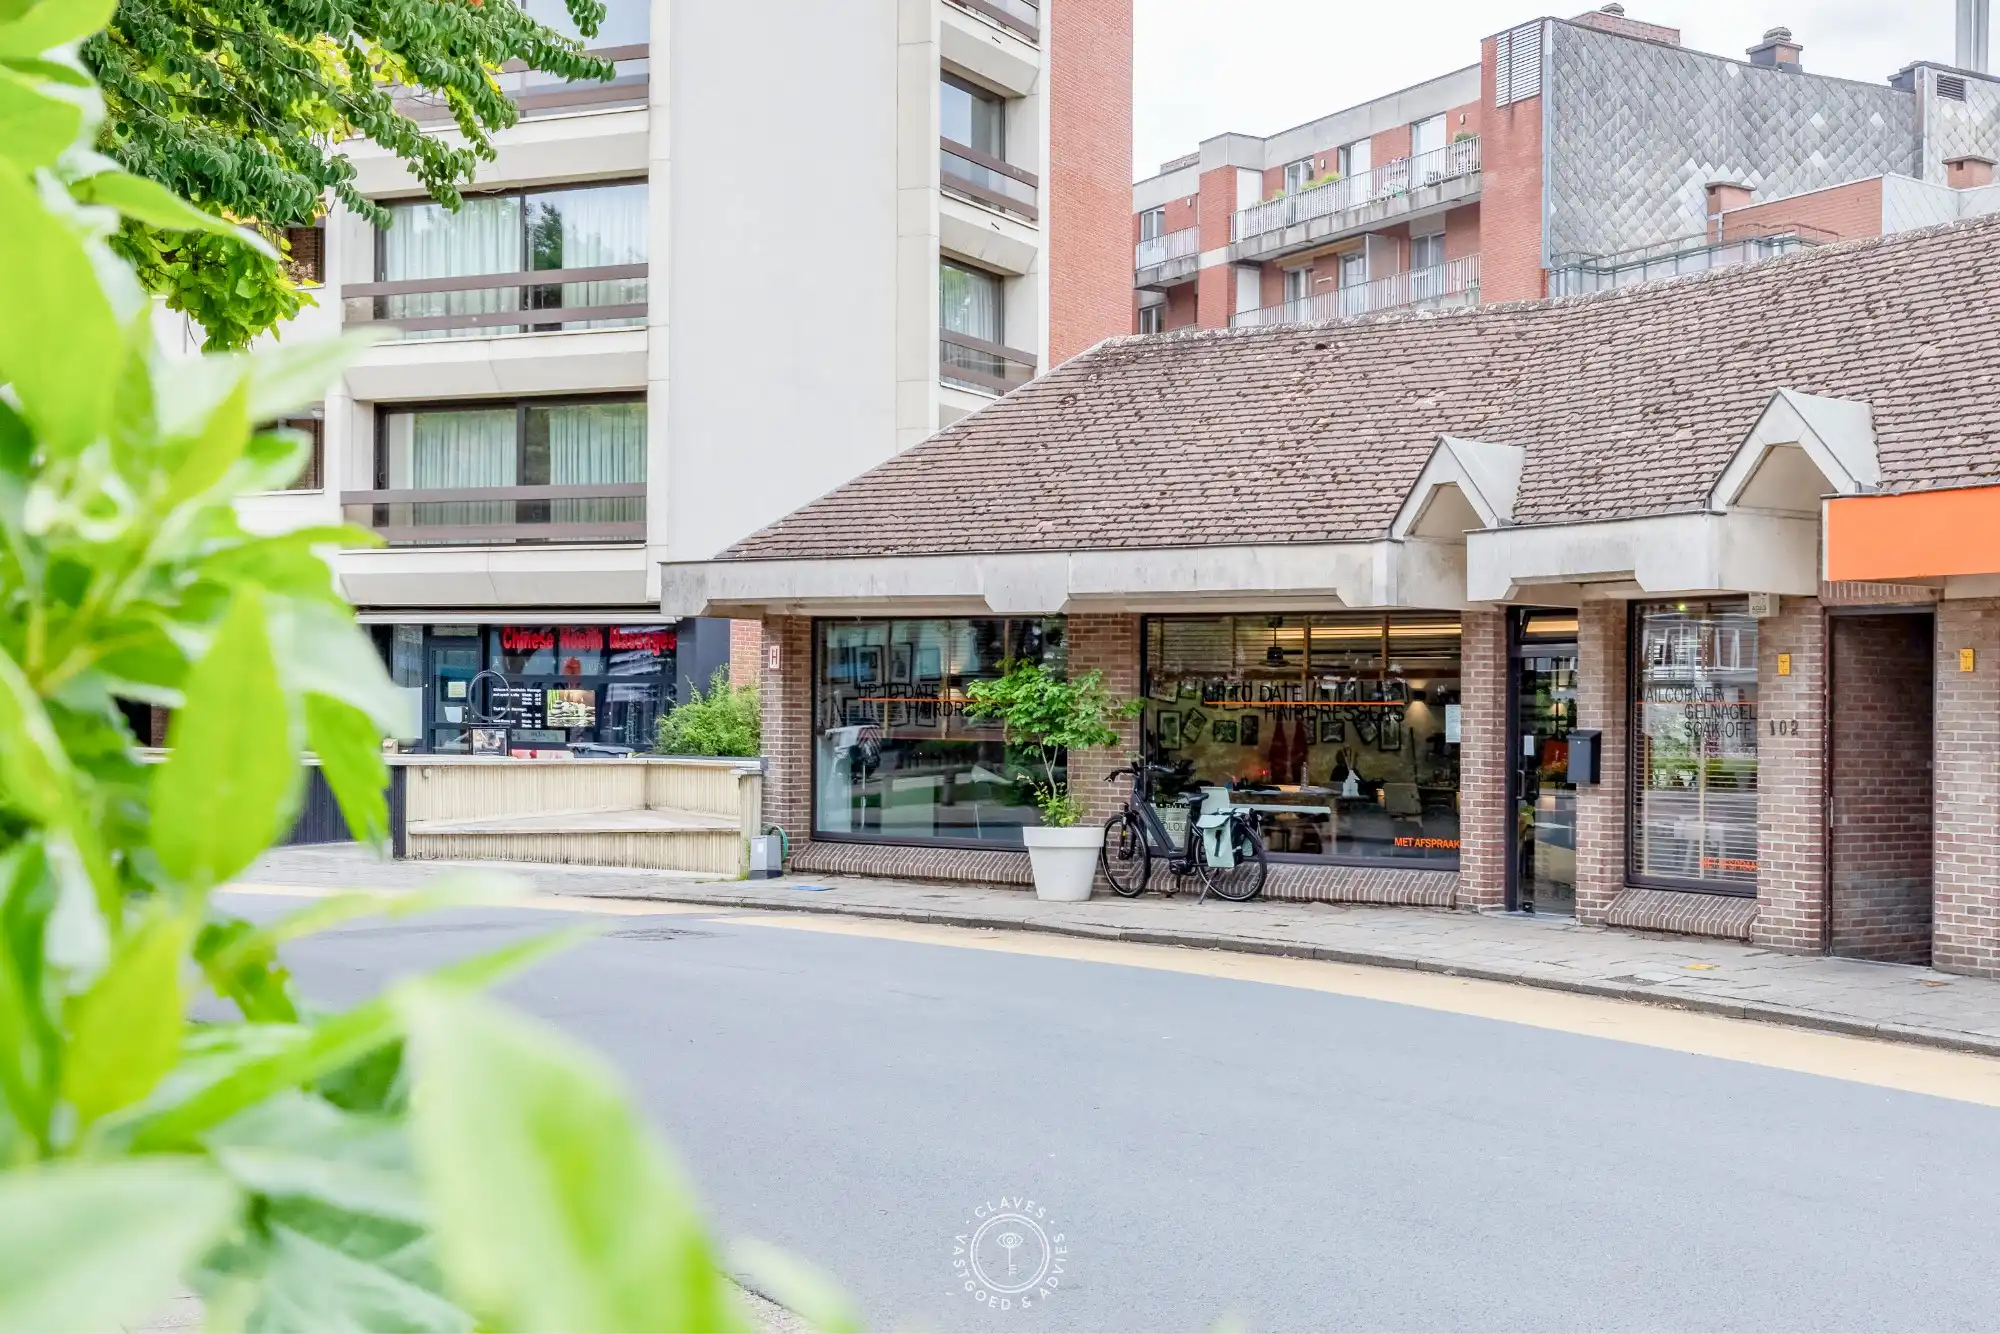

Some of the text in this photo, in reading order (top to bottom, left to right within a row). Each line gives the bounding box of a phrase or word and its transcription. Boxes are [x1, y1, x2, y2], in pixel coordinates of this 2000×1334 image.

[610, 625, 677, 656] Massages
[903, 683, 940, 698] DATE
[1259, 685, 1302, 702] DATE
[1684, 720, 1752, 738] SOAK-OFF
[1769, 719, 1799, 736] 102
[1394, 837, 1460, 849] MET AFSPRAAK
